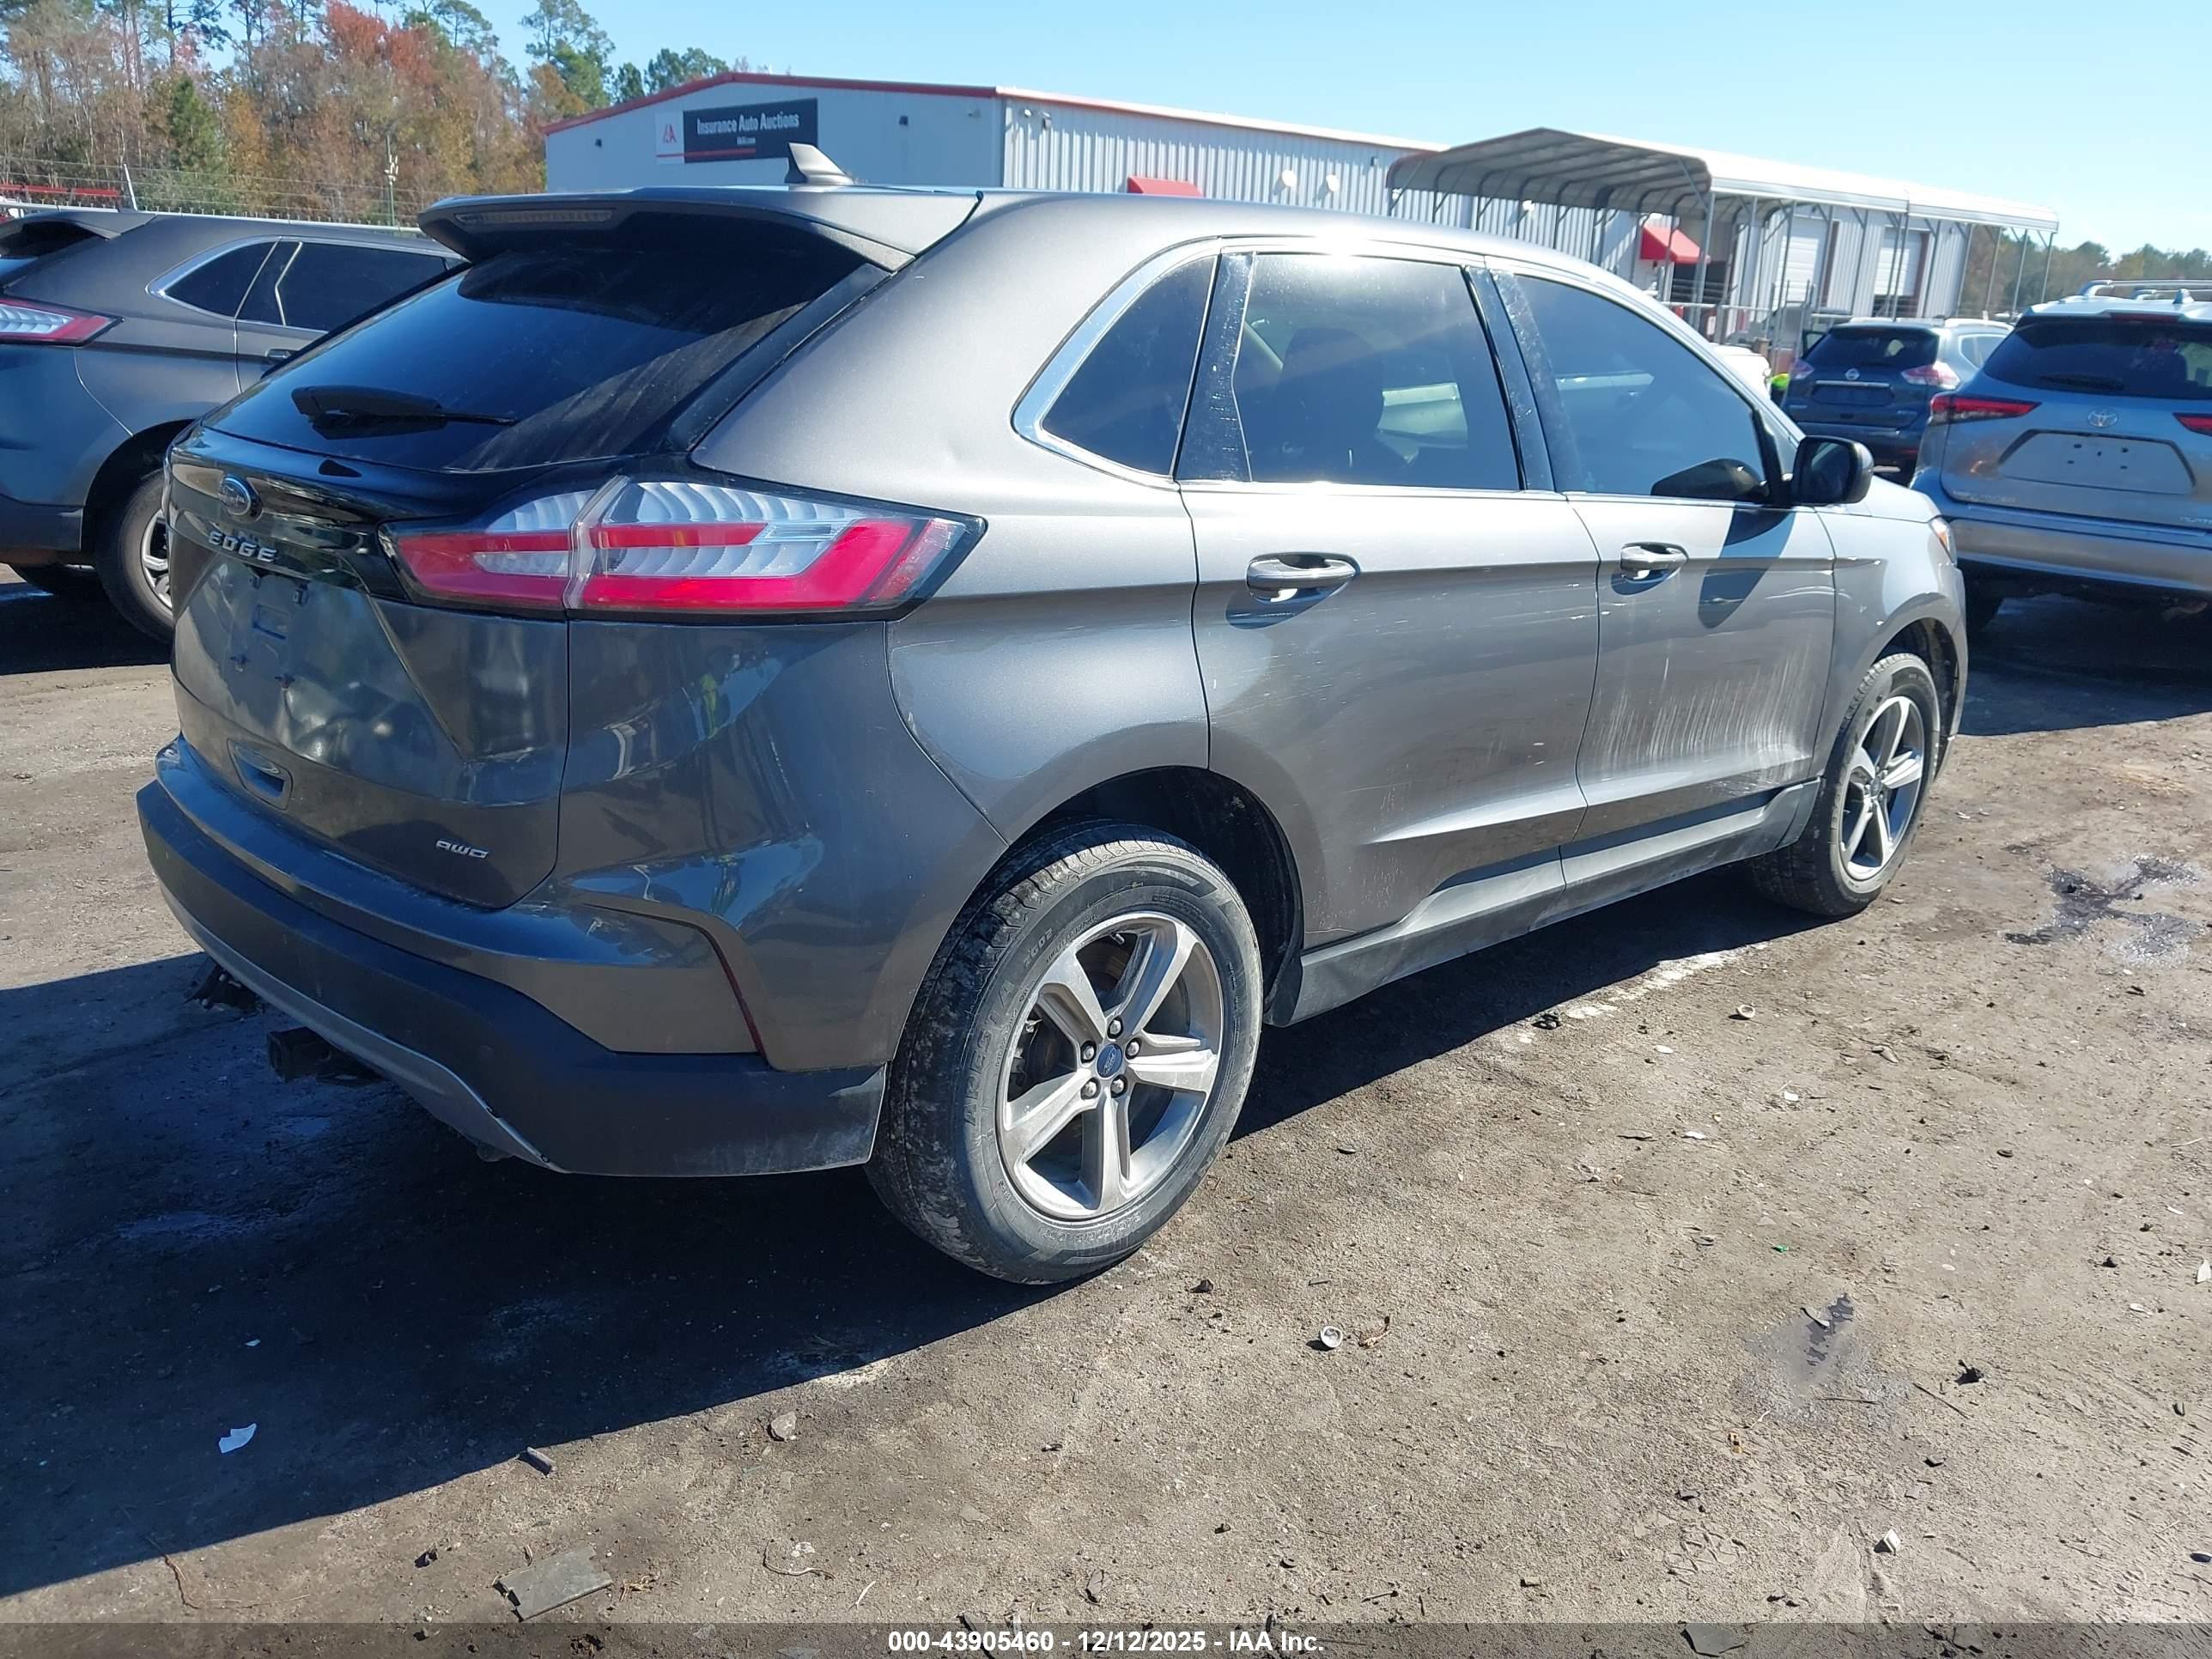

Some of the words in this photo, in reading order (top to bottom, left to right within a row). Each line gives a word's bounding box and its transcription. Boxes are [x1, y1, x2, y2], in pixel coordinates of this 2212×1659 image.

[696, 118, 738, 135] Insurance
[738, 114, 759, 131] Auto
[760, 111, 800, 131] Auctions
[208, 531, 277, 562] EDGE
[435, 840, 489, 859] AWD
